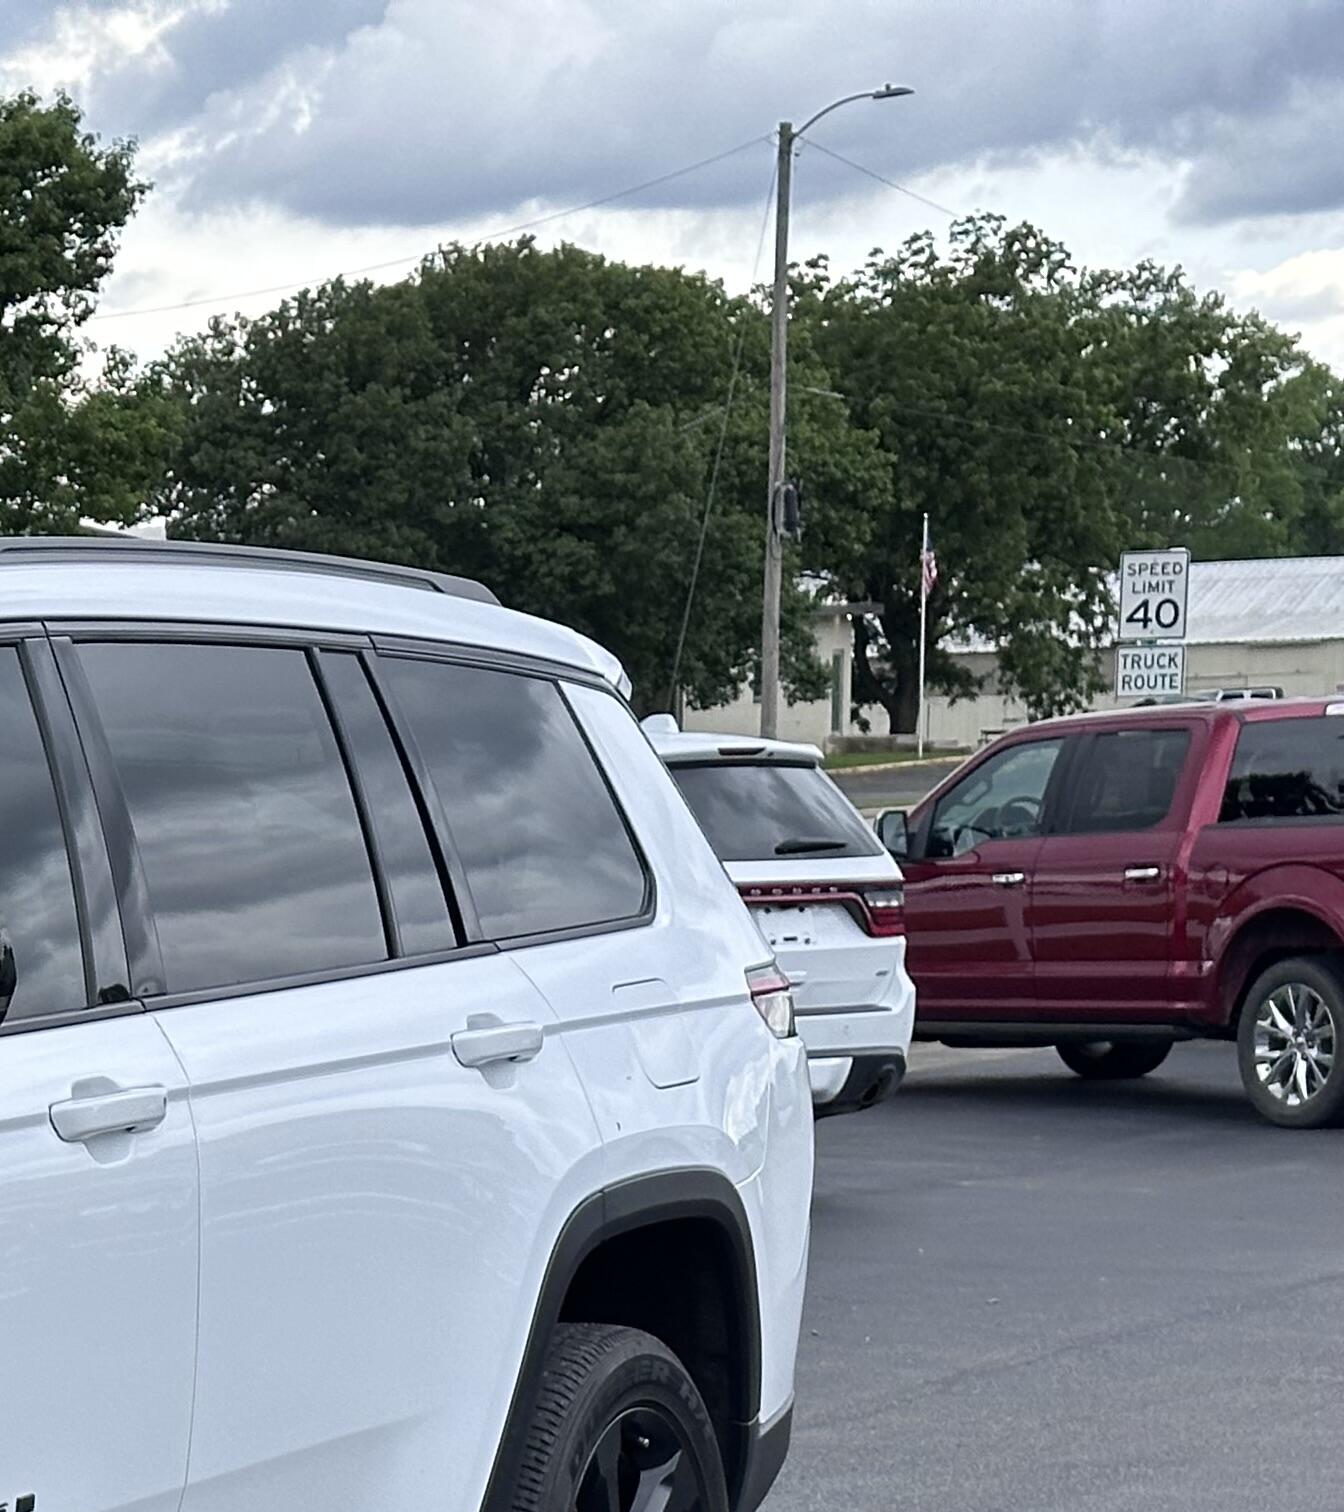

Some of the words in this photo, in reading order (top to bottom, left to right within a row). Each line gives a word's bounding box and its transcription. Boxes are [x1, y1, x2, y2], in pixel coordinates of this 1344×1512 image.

[1127, 561, 1184, 577] SPEED
[1131, 580, 1176, 595] LIMIT
[1125, 598, 1180, 630] 40
[1121, 652, 1179, 670] TRUCK
[1121, 673, 1179, 691] ROUTE
